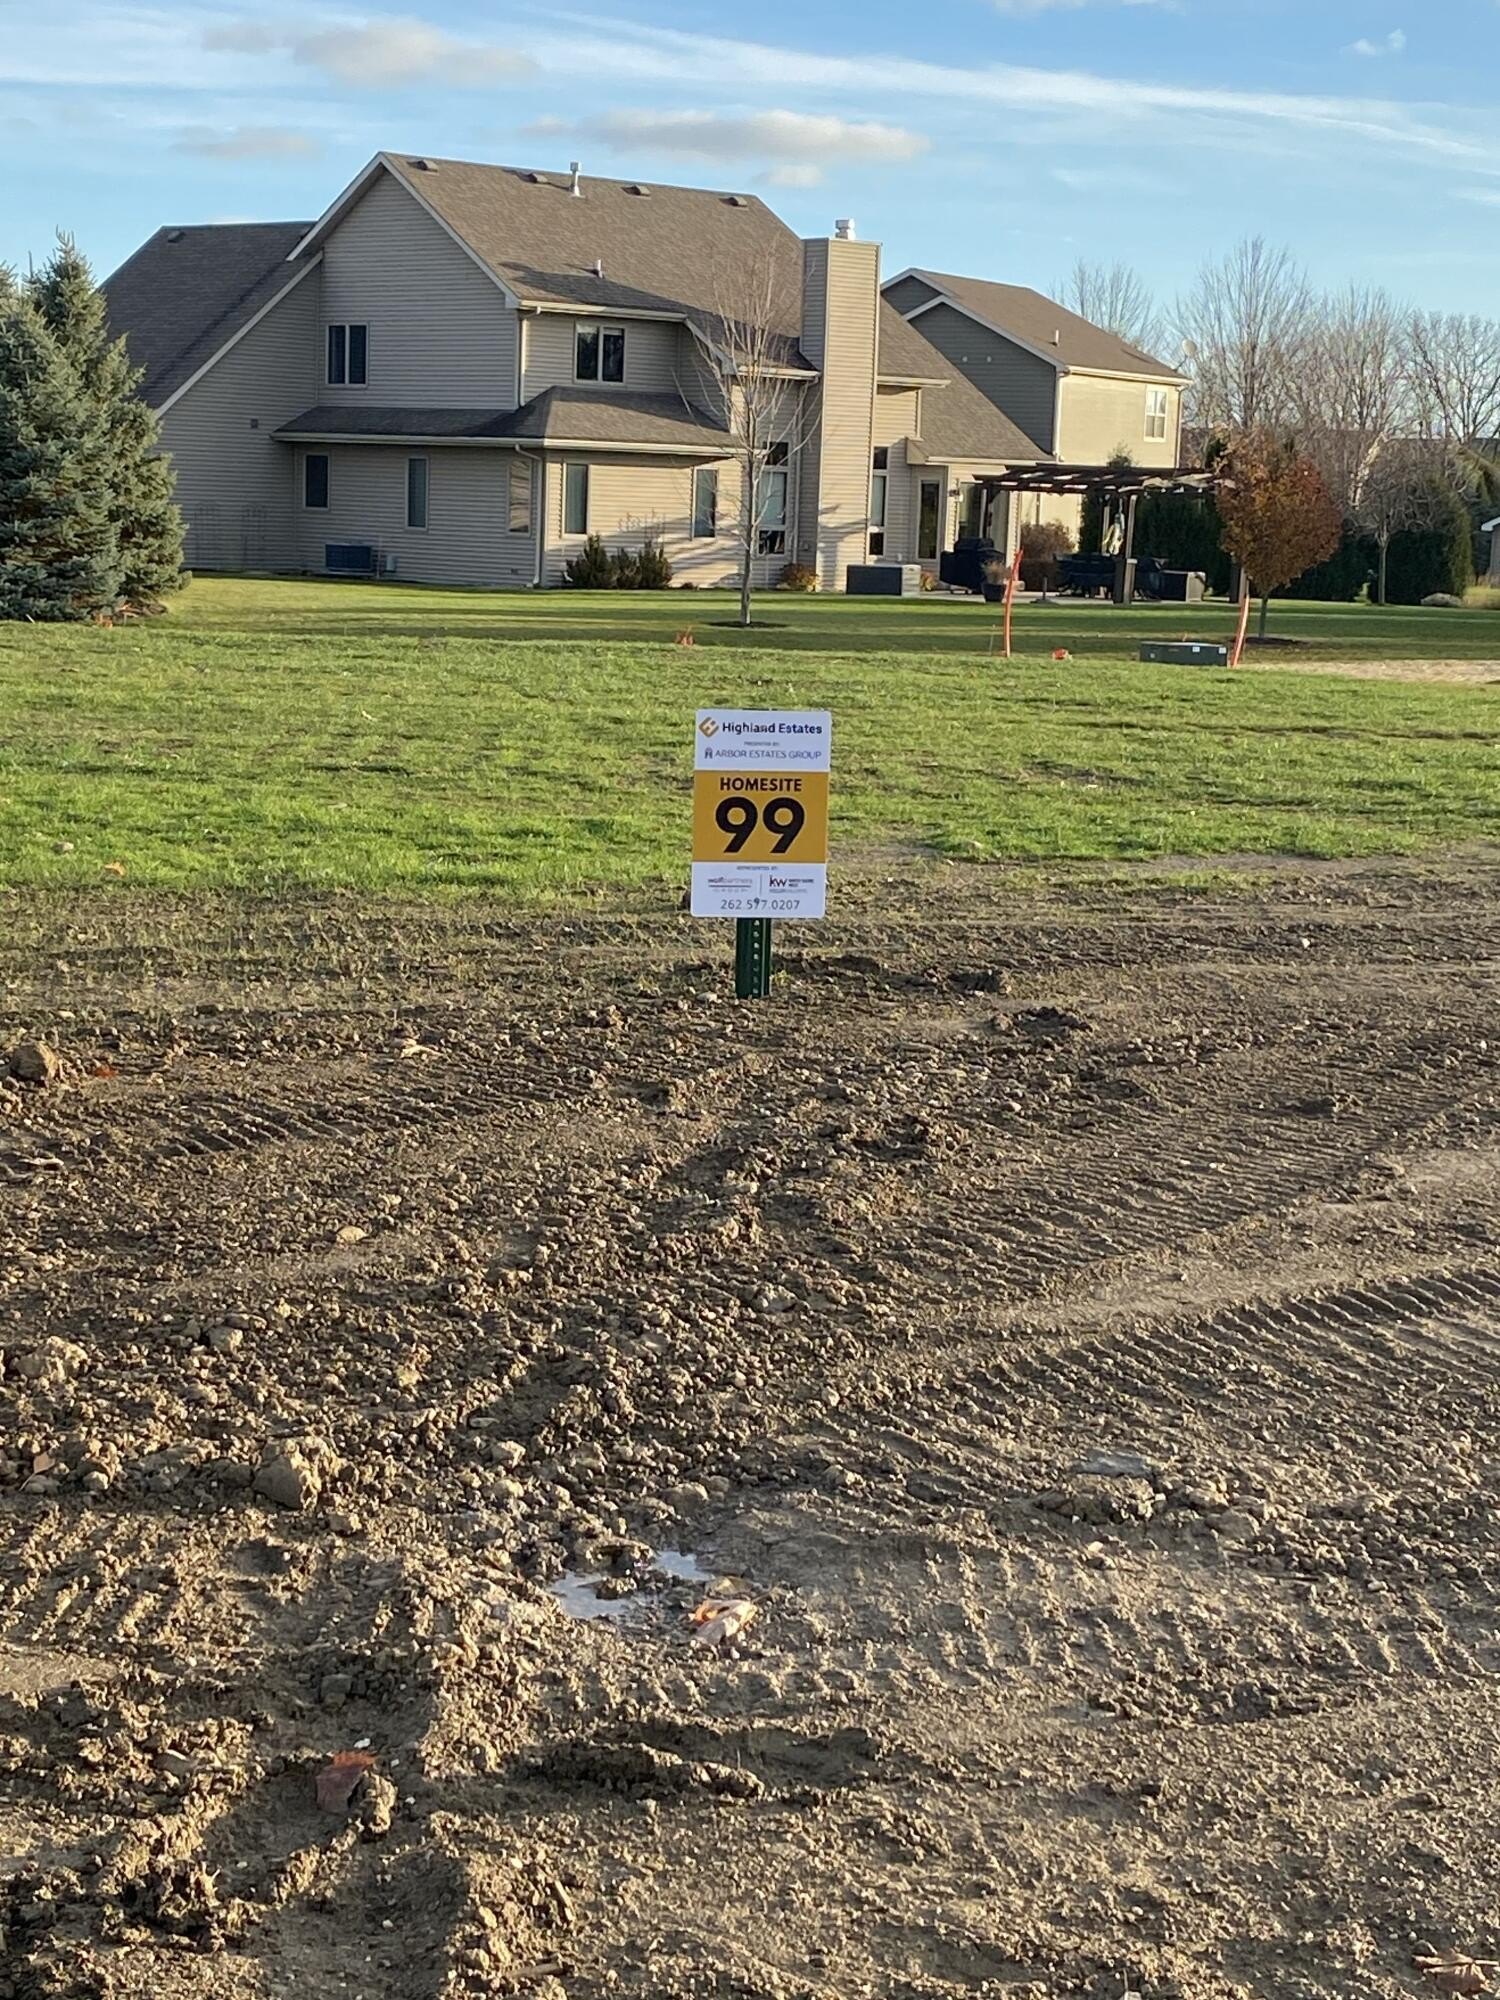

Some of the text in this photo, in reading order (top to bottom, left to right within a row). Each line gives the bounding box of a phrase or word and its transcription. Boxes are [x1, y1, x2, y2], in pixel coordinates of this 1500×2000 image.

[722, 721, 823, 735] Highland Estates
[714, 749, 822, 760] ARBOR ESTATES GROUP
[719, 777, 803, 792] HOMESITE
[715, 796, 805, 853] 99
